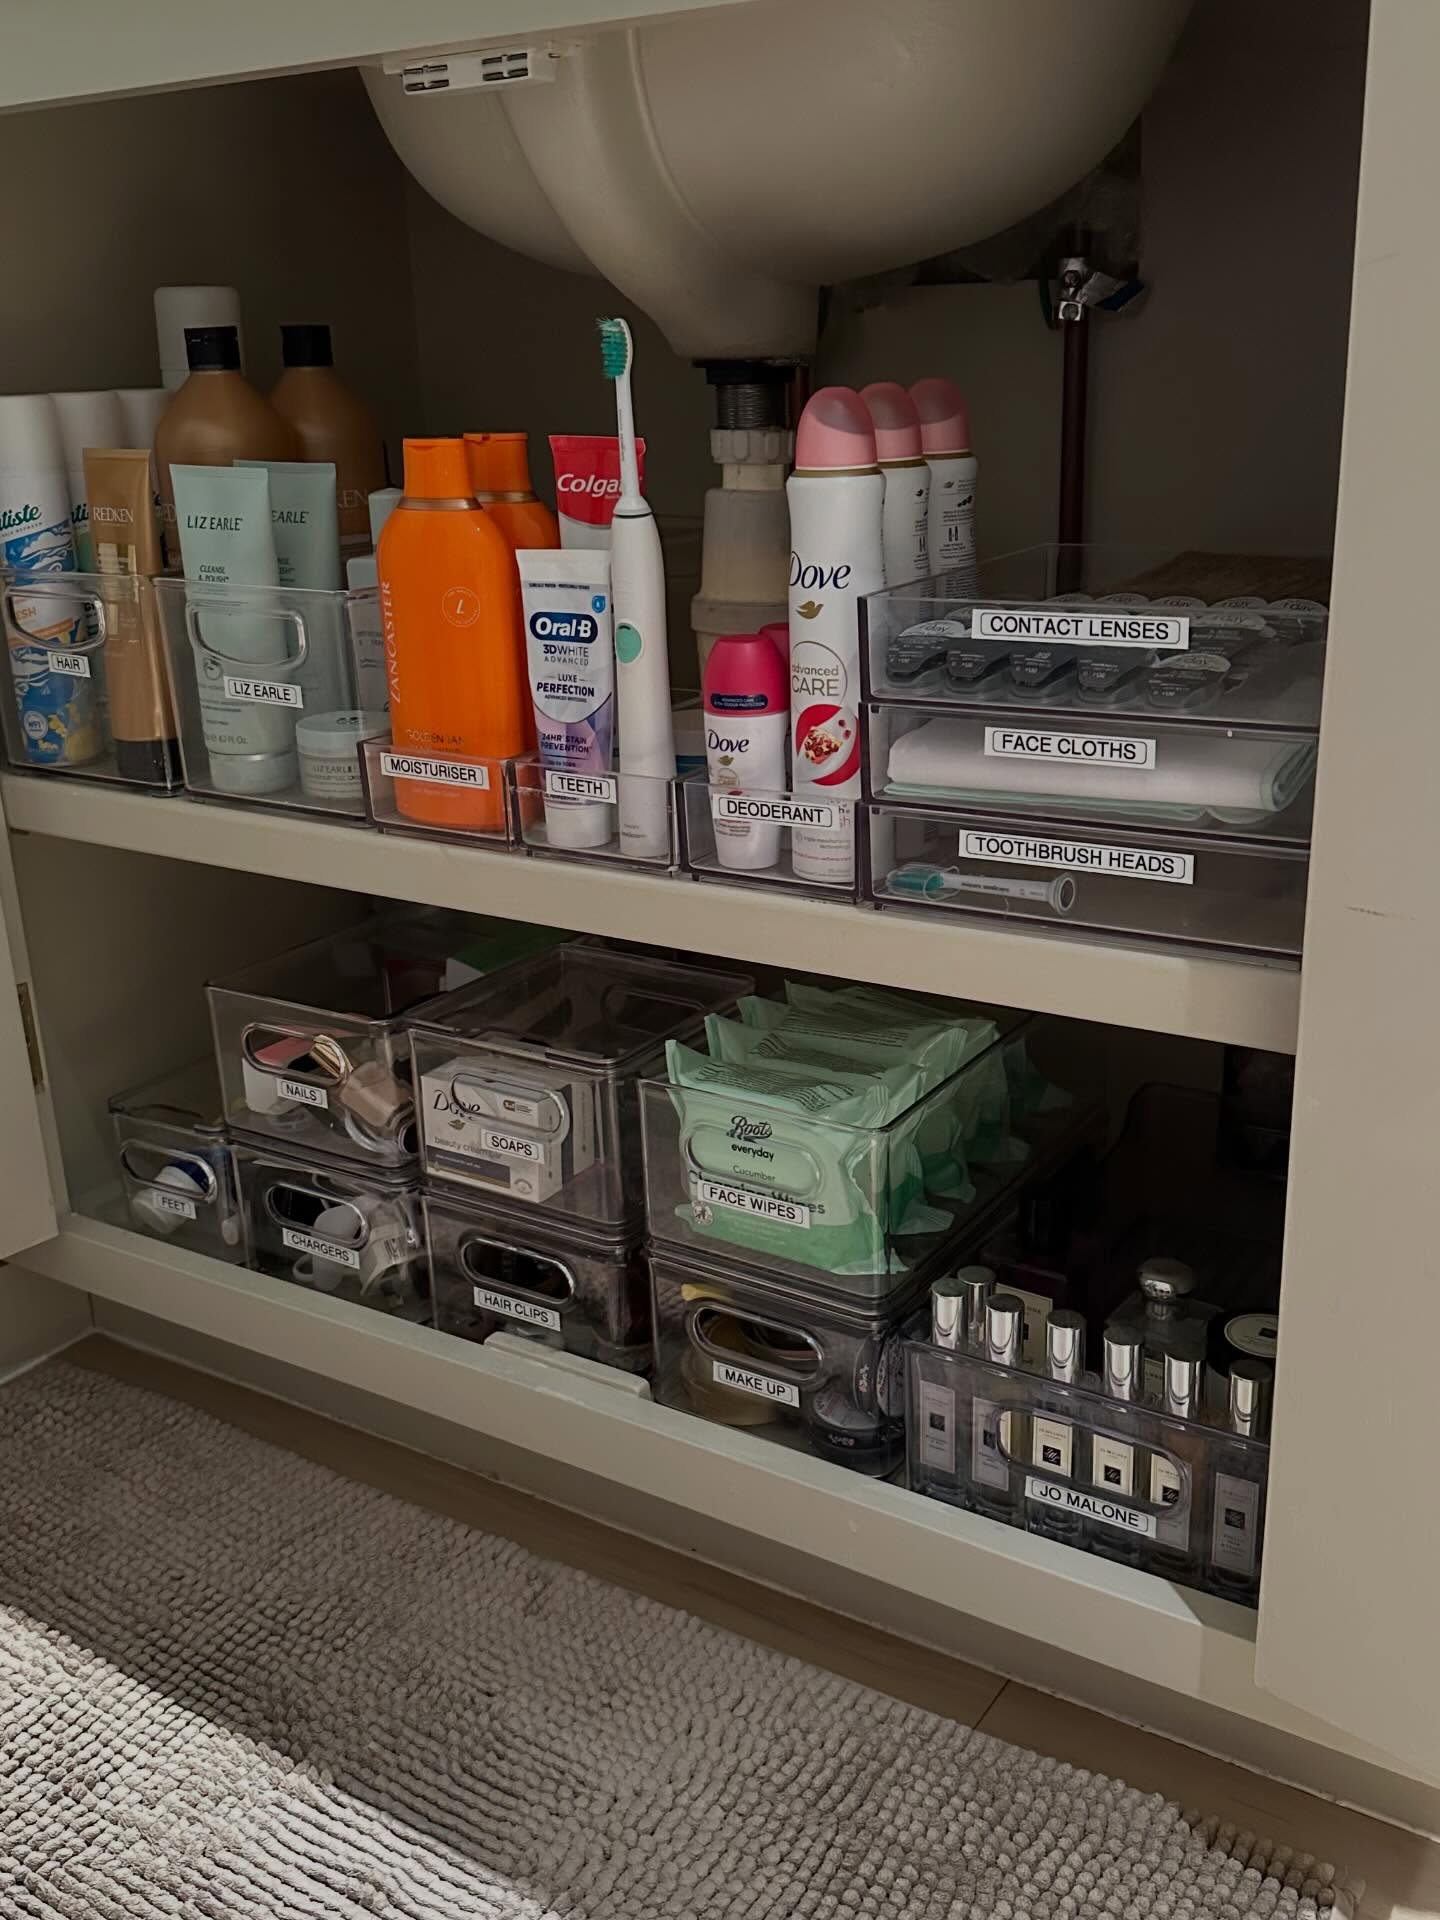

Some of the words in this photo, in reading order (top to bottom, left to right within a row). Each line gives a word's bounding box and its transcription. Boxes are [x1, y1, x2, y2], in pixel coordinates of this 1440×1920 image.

[557, 473, 622, 498] Colga
[0, 503, 42, 531] tiste
[93, 506, 134, 523] REDKEN
[187, 516, 207, 529] LIZ
[790, 550, 852, 590] Dove
[535, 616, 593, 638] Oral-B
[990, 615, 1084, 637] CONTACT
[1088, 619, 1170, 640] LENSES
[381, 581, 401, 703] LANCASTER
[56, 658, 81, 671] HAIR
[543, 656, 589, 667] ADVANCED
[558, 673, 578, 683] LUXE
[791, 675, 840, 697] CARE
[233, 682, 251, 696] LIZ
[253, 684, 292, 702] EARLE
[536, 682, 595, 698] PERFECTION
[565, 735, 587, 745] STAIN
[707, 729, 750, 753] Dove
[1001, 734, 1052, 754] FACE
[1057, 738, 1137, 760] CLOTHS
[390, 758, 477, 782] MOISTURISER
[558, 776, 603, 796] TEETH
[727, 799, 824, 824] DEODERANT
[976, 836, 1102, 868] TOOTHBRUSH
[1108, 852, 1175, 875] HEADS
[286, 1083, 317, 1101] NAILS
[491, 1135, 532, 1157] SOAPS
[731, 1142, 775, 1162] everyday
[733, 1164, 776, 1183] Cucumber
[161, 1196, 186, 1213] FEET
[710, 1186, 746, 1207] FACE
[749, 1198, 796, 1220] WIPES
[291, 1234, 350, 1262] CHARGERS
[484, 1293, 512, 1311] HAIR
[514, 1303, 548, 1323] CLIPS
[725, 1368, 762, 1391] MAKE
[766, 1383, 786, 1397] UP
[1039, 1485, 1062, 1501] JO
[1066, 1492, 1140, 1527] MALONE
